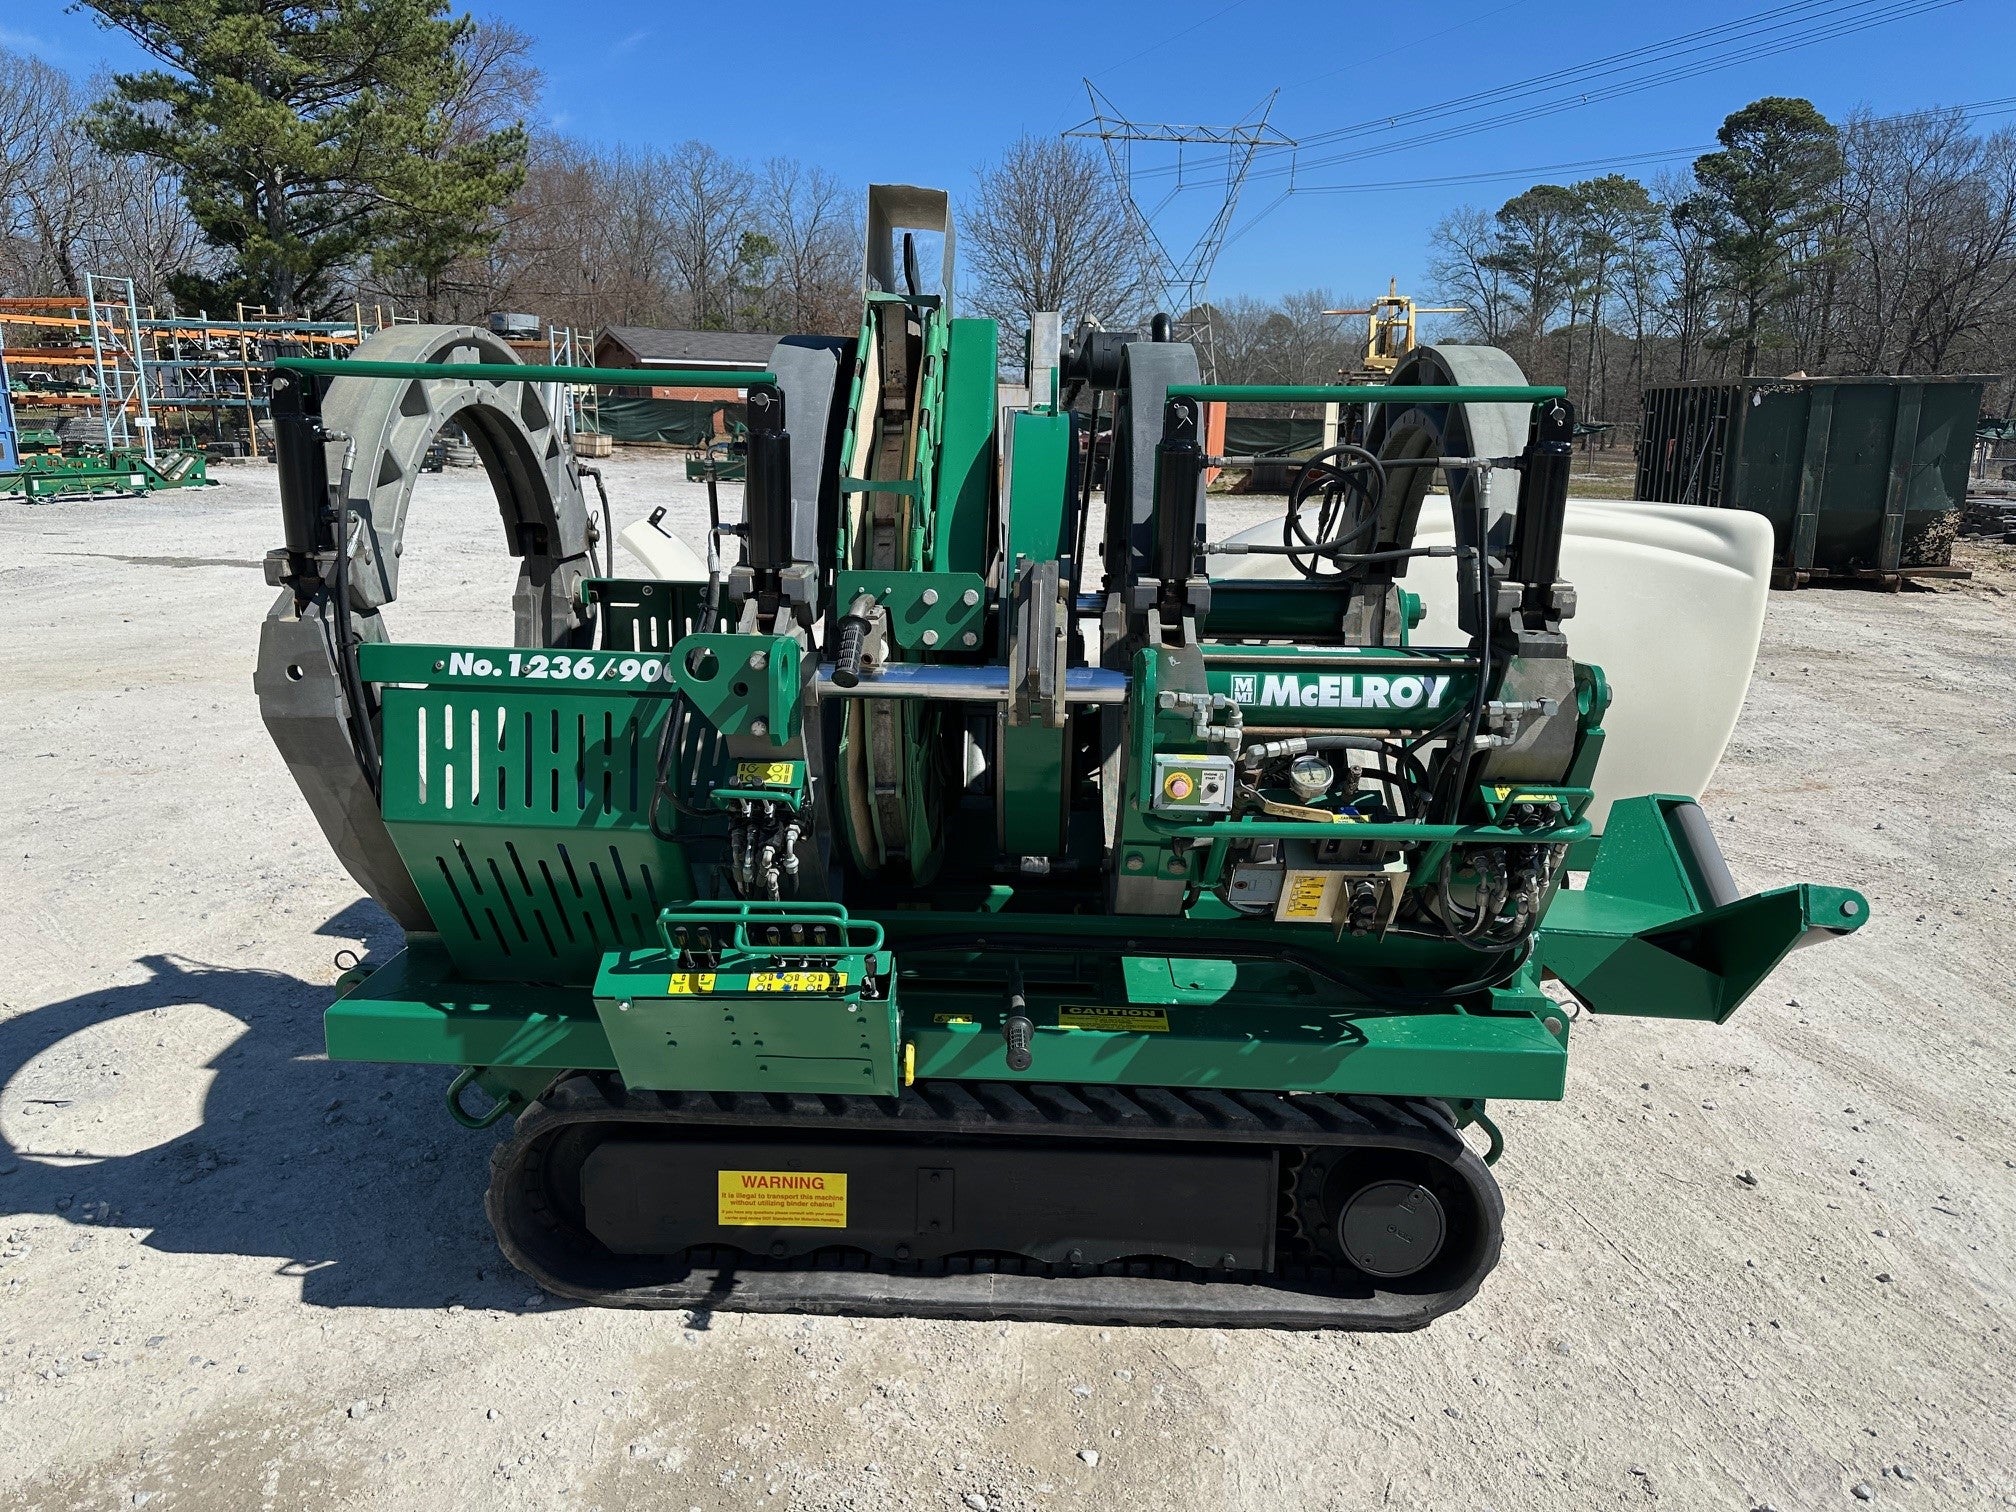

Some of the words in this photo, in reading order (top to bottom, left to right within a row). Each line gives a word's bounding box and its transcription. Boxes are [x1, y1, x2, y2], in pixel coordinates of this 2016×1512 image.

[449, 652, 502, 677] No.
[1260, 674, 1450, 708] McELROY
[1069, 1007, 1156, 1017] CAUTION
[741, 1175, 825, 1190] WARNING
[735, 1192, 757, 1200] illegal
[766, 1193, 799, 1201] transport
